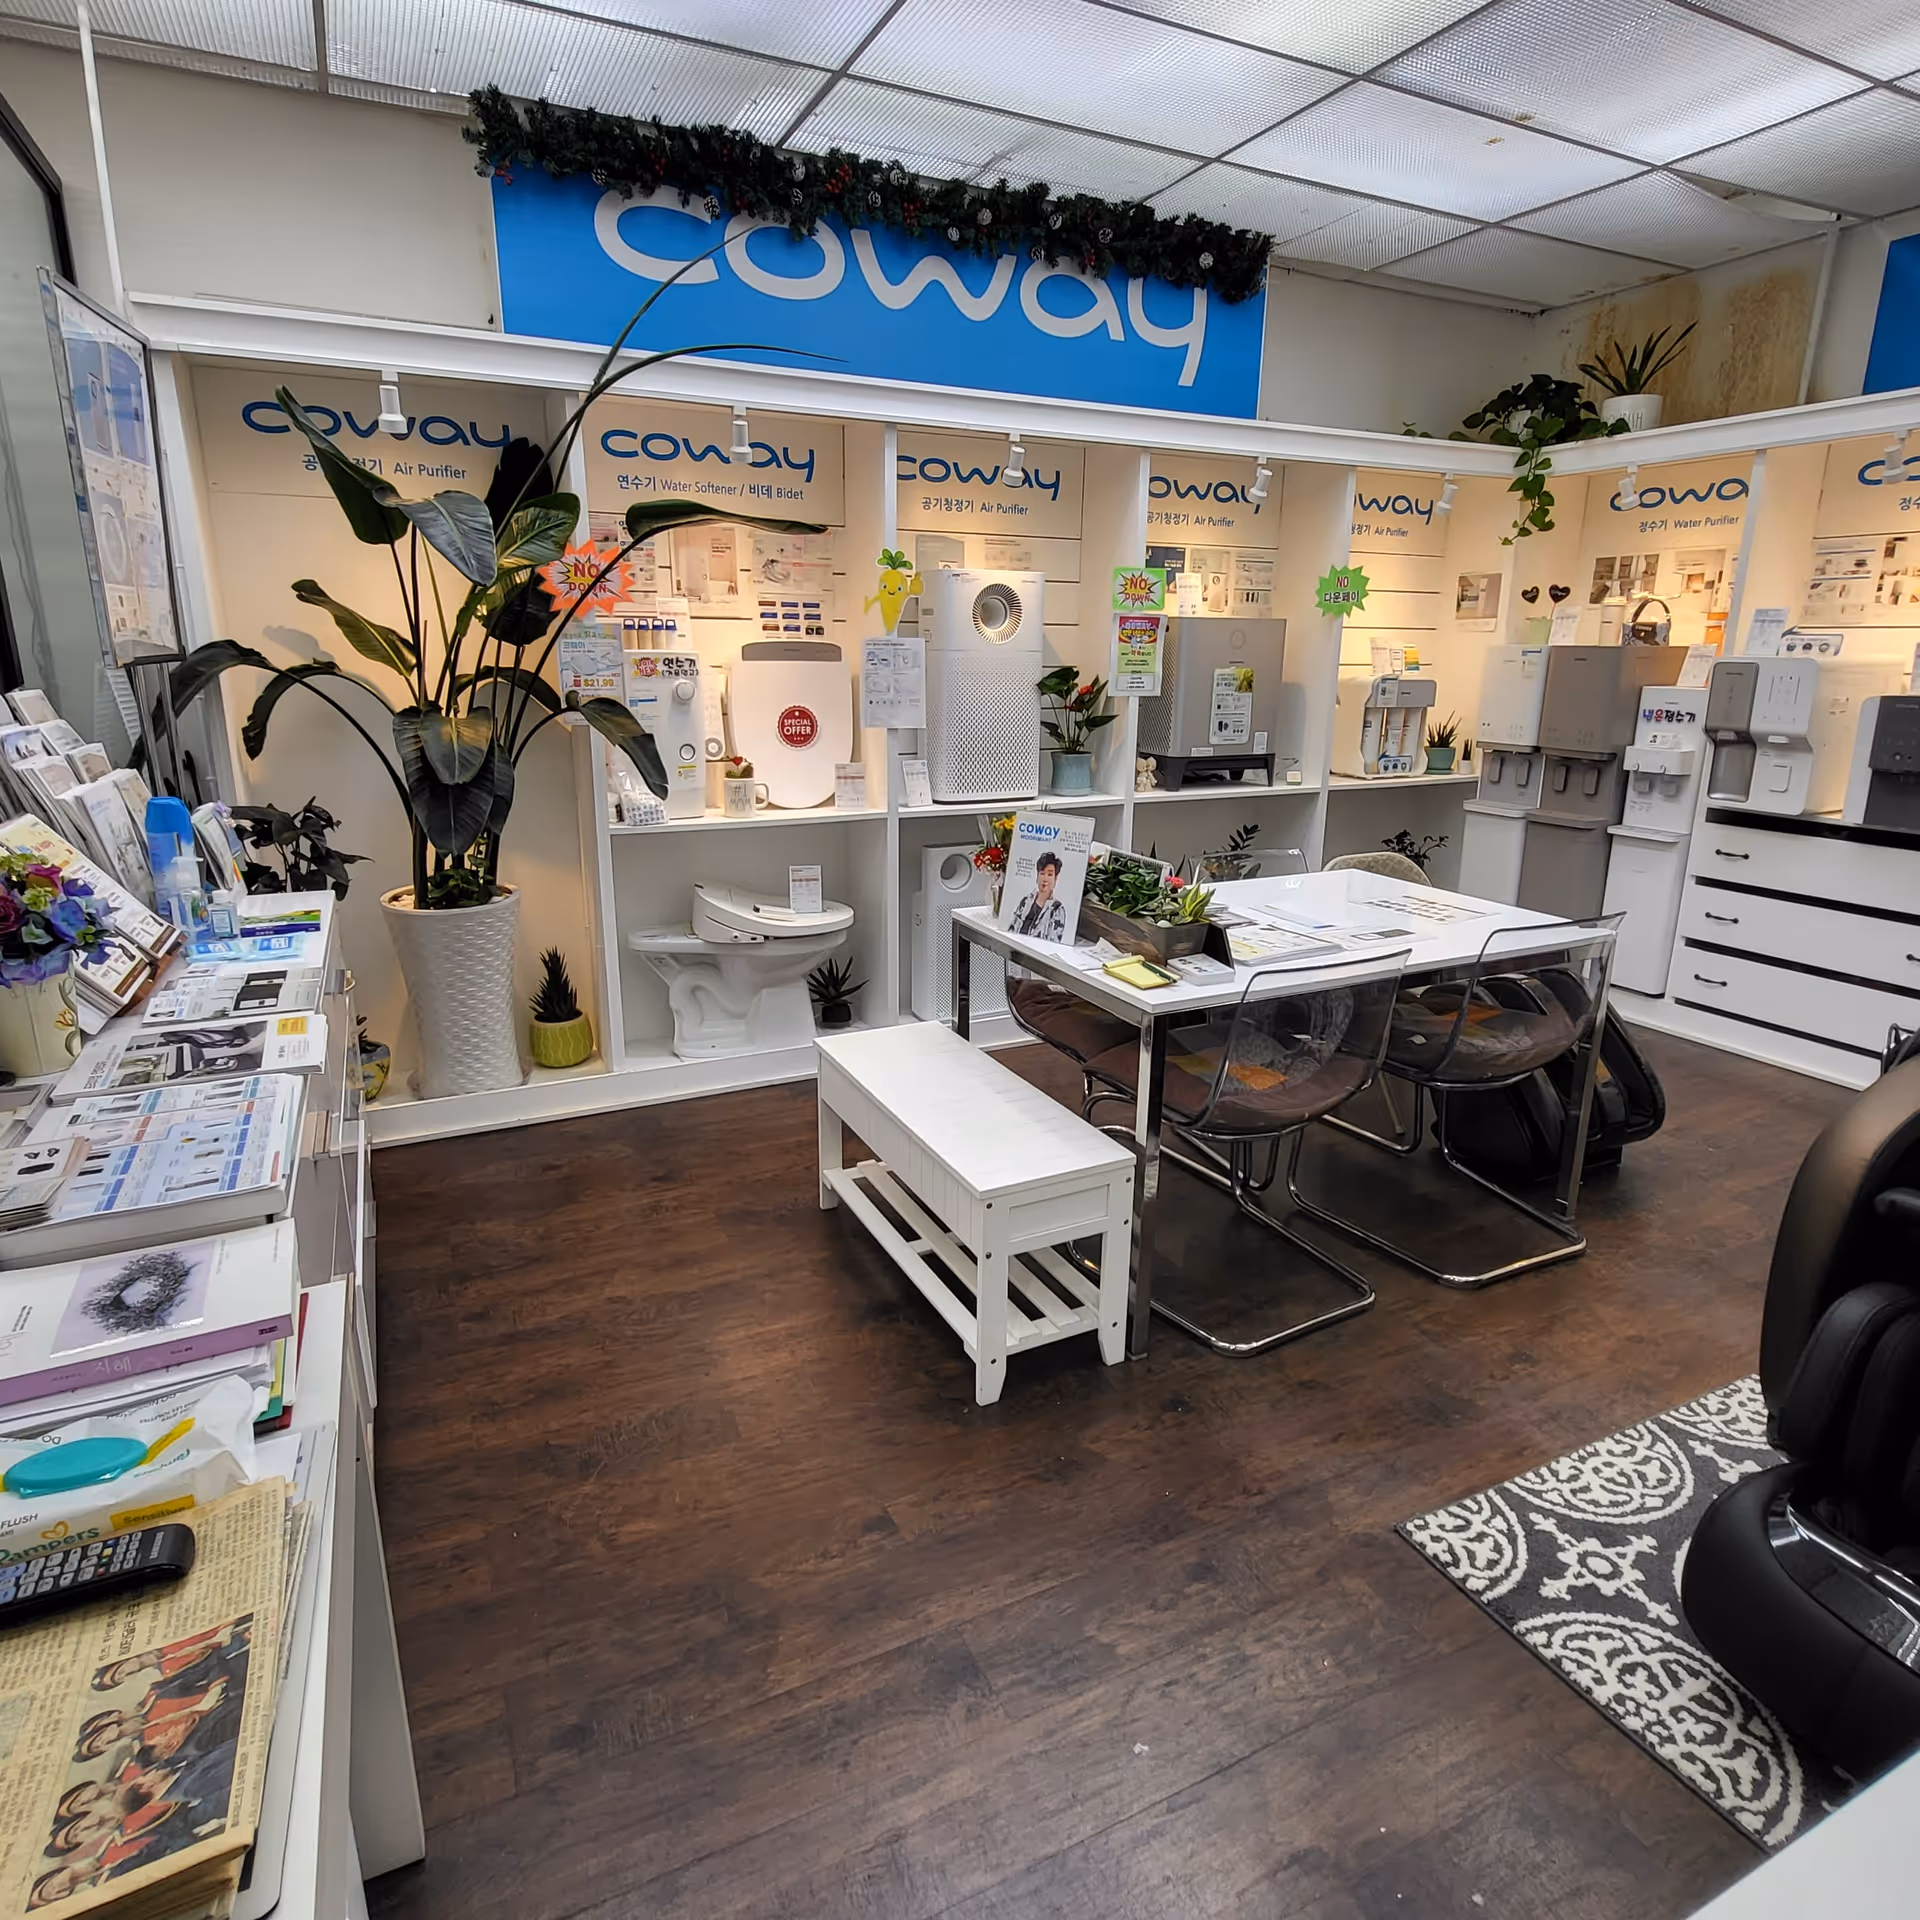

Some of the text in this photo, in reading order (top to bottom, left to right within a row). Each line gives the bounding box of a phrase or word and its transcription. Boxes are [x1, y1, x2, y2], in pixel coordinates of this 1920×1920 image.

[594, 187, 1207, 387] coway
[601, 429, 815, 483] coway
[393, 461, 414, 476] Air
[417, 463, 467, 480] Purifier
[617, 474, 657, 492] 연수기
[660, 478, 692, 493] Water
[695, 481, 737, 496] Softener
[749, 483, 773, 499] 비데
[776, 486, 804, 500] Bidet
[1149, 475, 1261, 515] oway
[1609, 477, 1749, 511] cowa
[921, 496, 1028, 516] 공기청정기 Air Purifier
[1354, 491, 1434, 526] way
[1194, 515, 1206, 527] Air
[1207, 516, 1235, 528] Purifier
[1639, 514, 1739, 533] 정수기 Water Purifier
[1385, 527, 1409, 538] Purifier
[573, 562, 601, 579] NO
[1129, 577, 1148, 591] NO
[1336, 576, 1349, 588] NO
[1124, 592, 1151, 602] DOWN
[1323, 590, 1359, 604] 다운페이
[583, 678, 614, 687] $21.99
[783, 718, 811, 726] SPECIAL
[1642, 708, 1696, 723] 냉온정수기
[783, 726, 811, 735] OFFER
[0, 1513, 39, 1529] FLUSH
